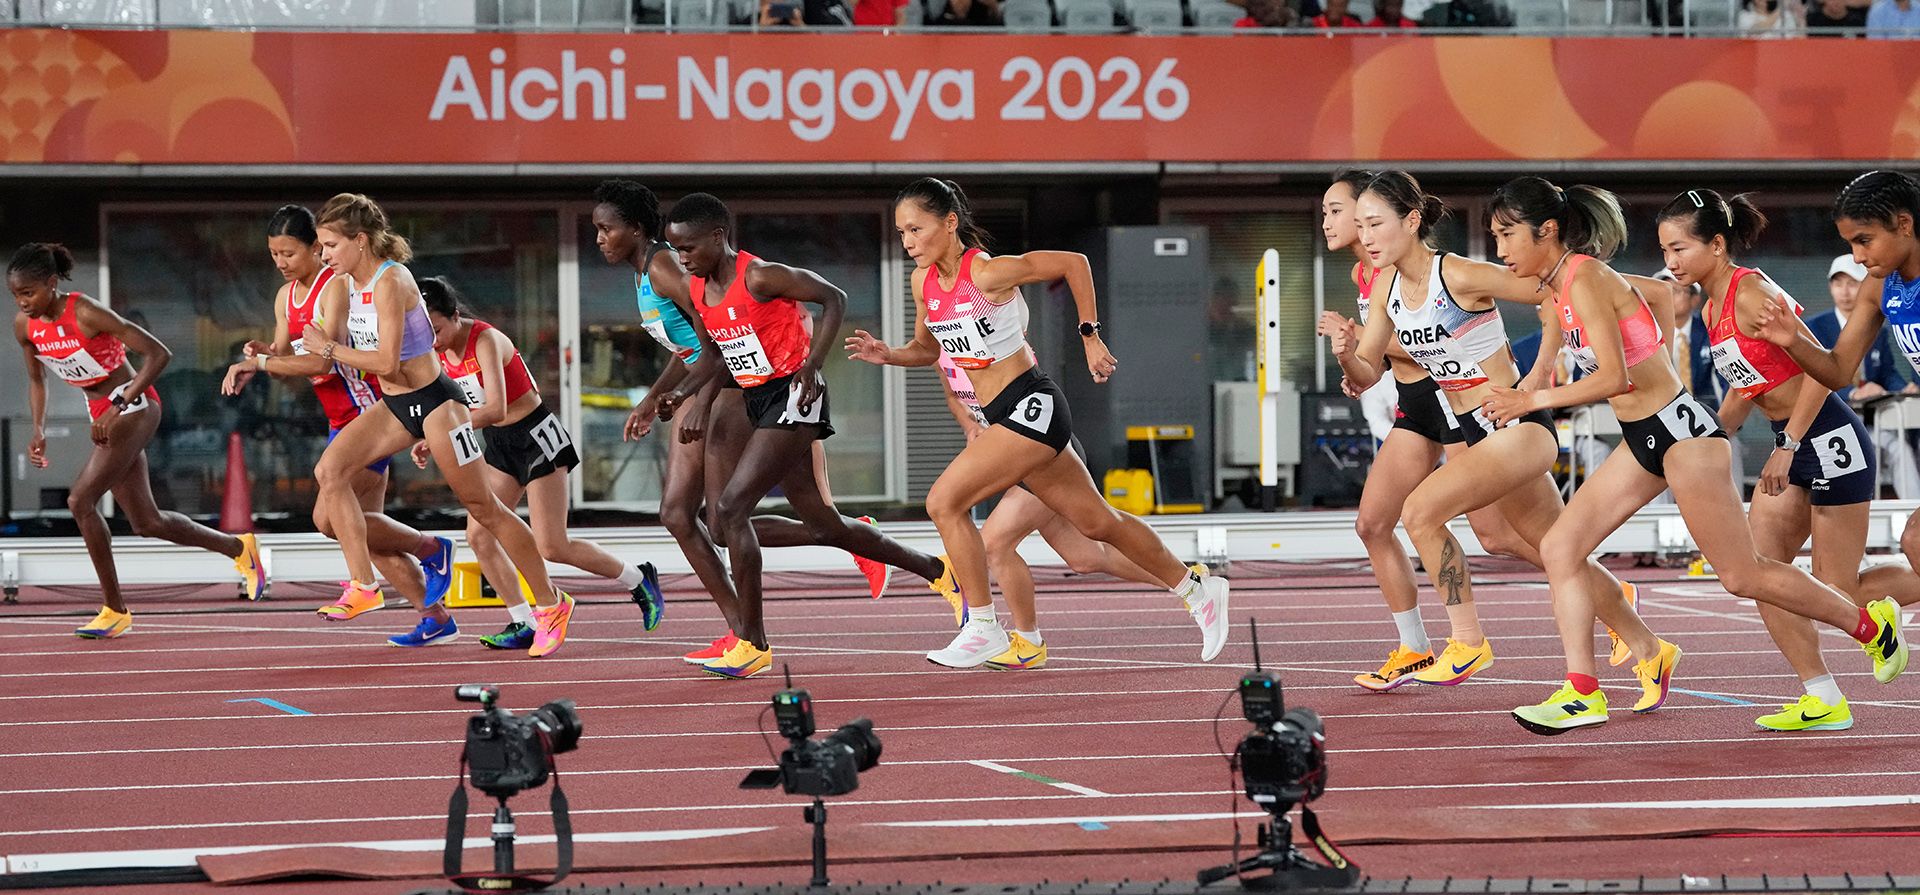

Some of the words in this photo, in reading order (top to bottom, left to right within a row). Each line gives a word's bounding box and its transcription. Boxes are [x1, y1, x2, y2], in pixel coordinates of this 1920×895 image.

[429, 49, 974, 141] Aichi-Nagoya
[1000, 56, 1190, 121] 2026
[719, 340, 746, 352] ORNAN
[942, 335, 972, 353] OW
[754, 366, 768, 375] 220
[1463, 368, 1477, 379] 492
[1741, 374, 1758, 386] 802
[1024, 397, 1043, 422] 6
[1676, 403, 1707, 438] 2
[455, 427, 479, 459] 10
[537, 419, 563, 454] 11
[1828, 436, 1852, 469] 3
[1397, 656, 1434, 675] NITRO
